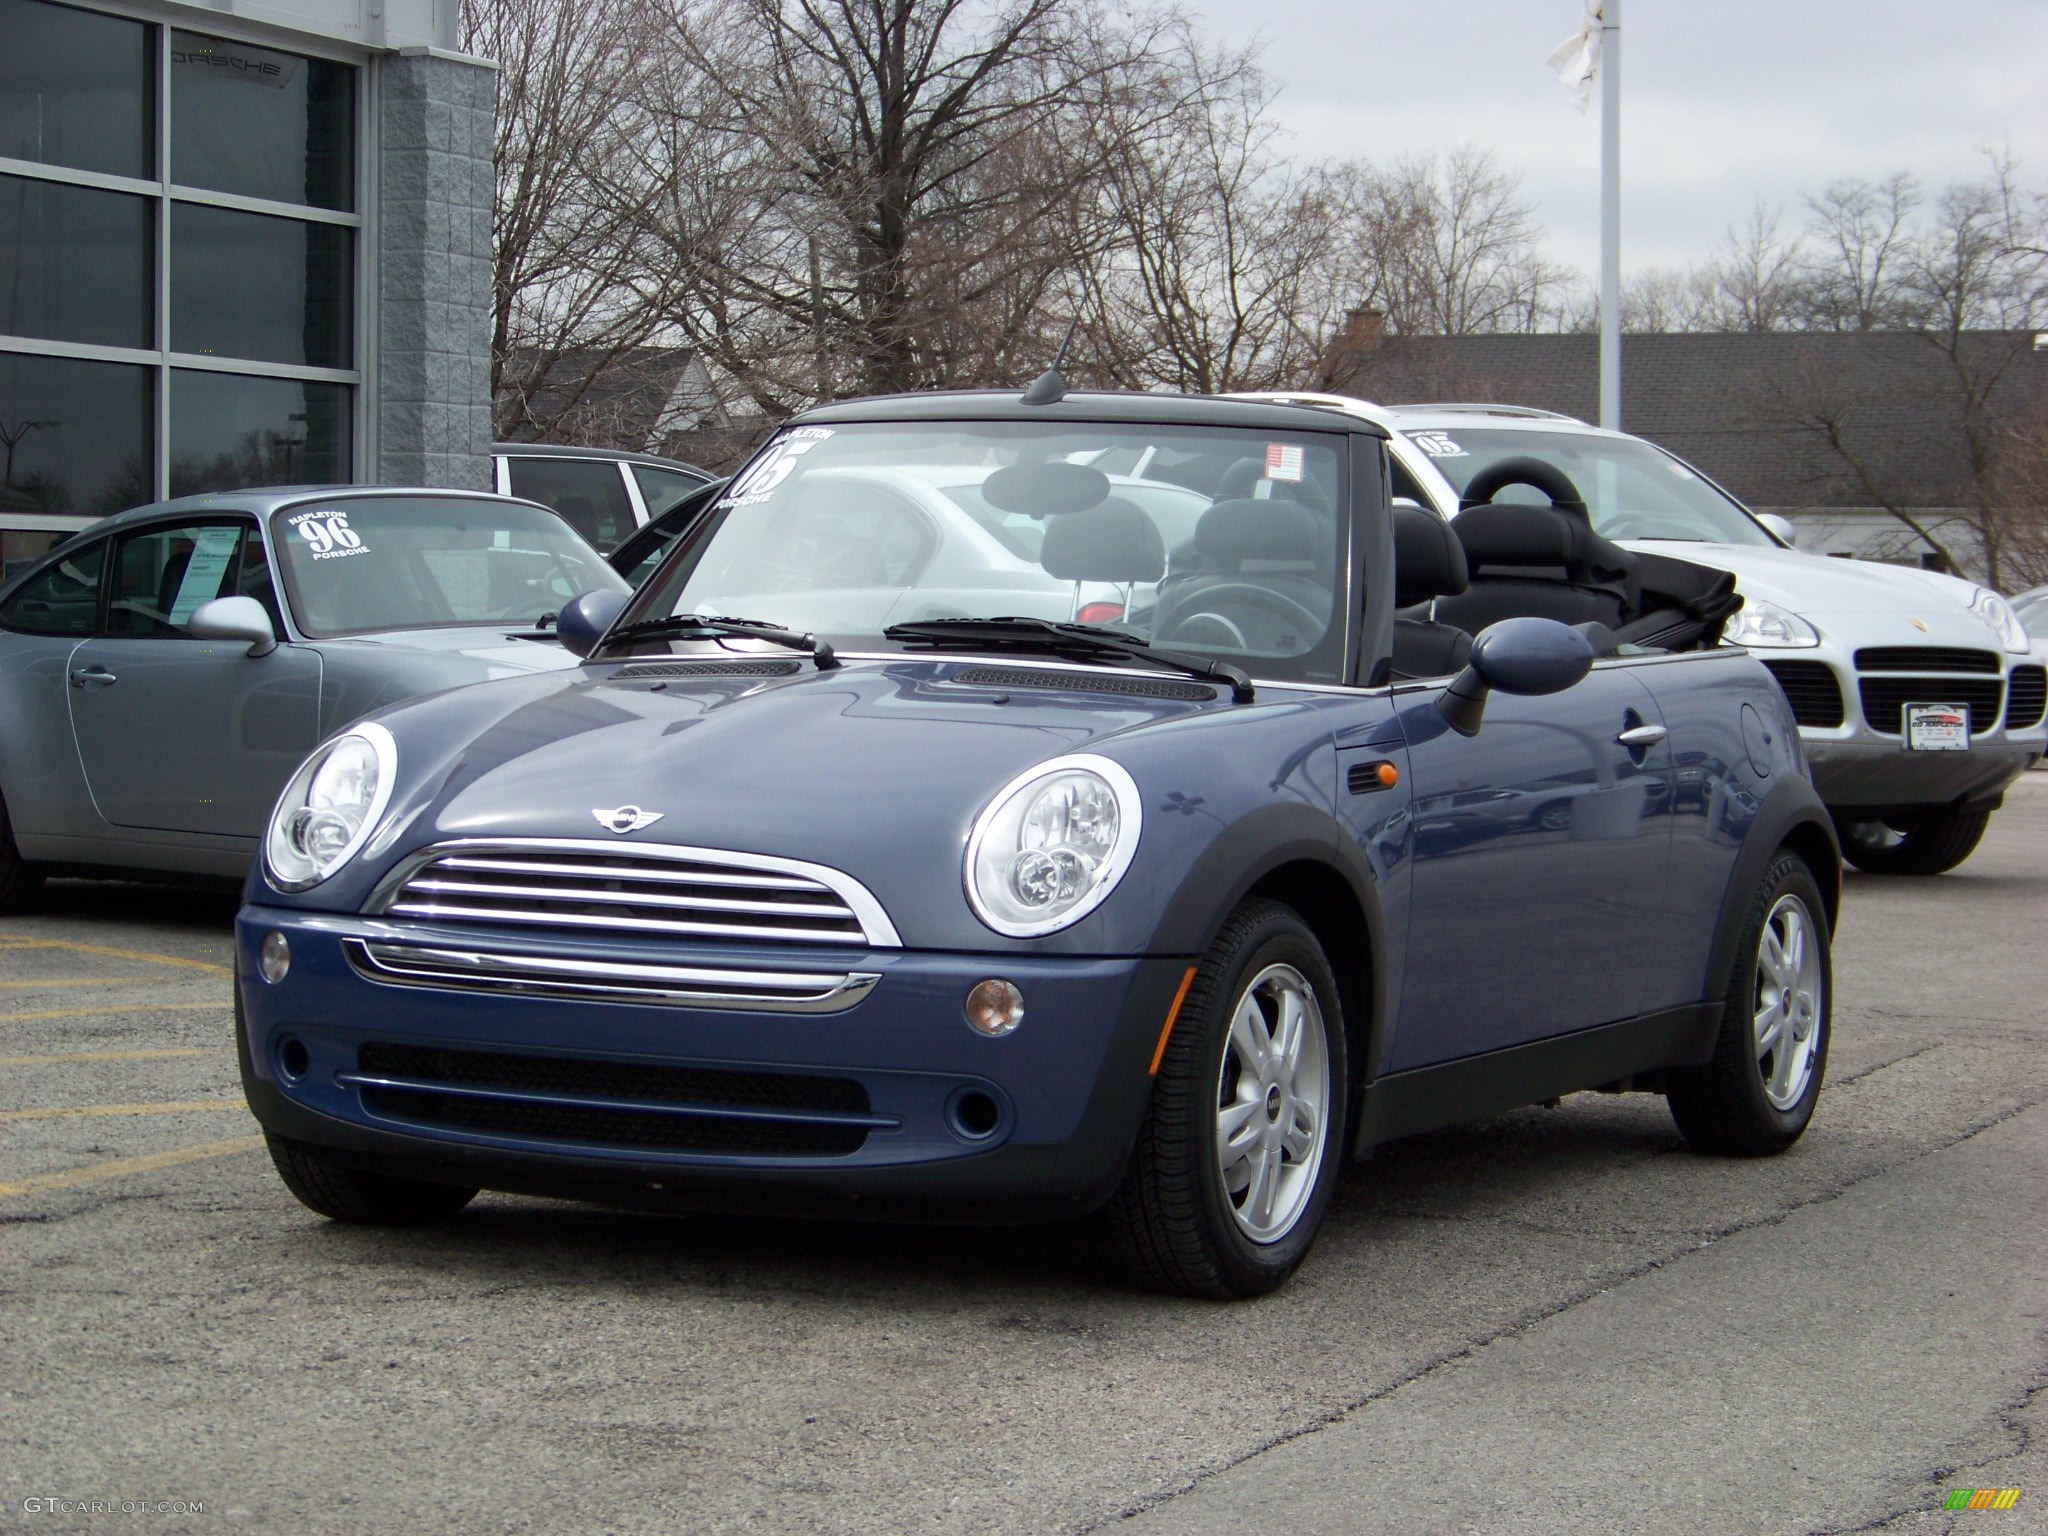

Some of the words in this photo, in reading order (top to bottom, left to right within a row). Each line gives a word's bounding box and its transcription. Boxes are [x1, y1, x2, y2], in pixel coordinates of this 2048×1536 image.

[171, 50, 282, 76] ORSCHE
[1415, 435, 1462, 454] 05
[729, 440, 819, 498] 05
[288, 511, 348, 526] NAPLETON
[298, 517, 361, 553] 96
[312, 545, 371, 561] PORSCHE
